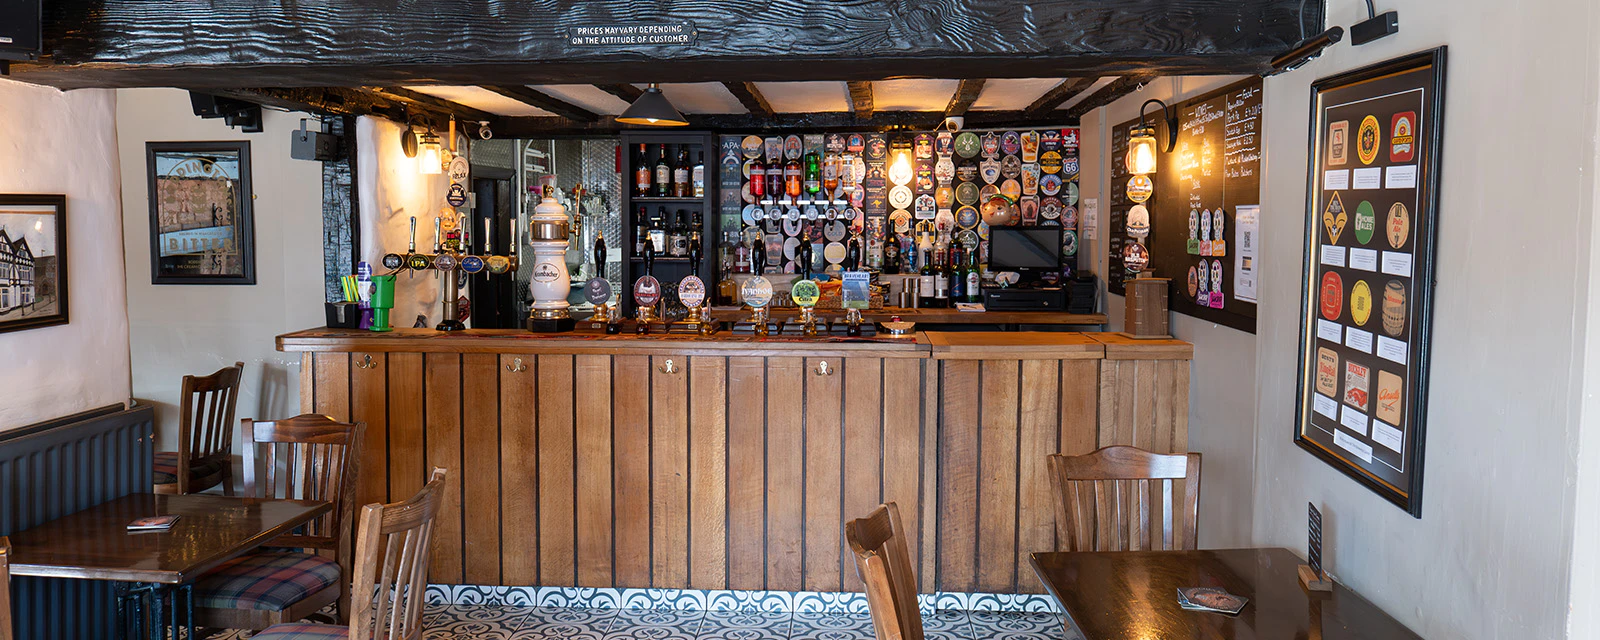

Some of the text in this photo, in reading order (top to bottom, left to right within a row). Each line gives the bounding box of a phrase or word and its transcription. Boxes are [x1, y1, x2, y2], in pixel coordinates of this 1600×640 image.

[577, 25, 682, 35] PRICES MAY VARY DEPENDING
[572, 34, 689, 45] ON THE ATTITUDE OF CUSTOMER
[723, 141, 740, 150] APA
[1065, 163, 1077, 173] 66
[169, 237, 232, 252] BITTER
[411, 260, 426, 268] IPA
